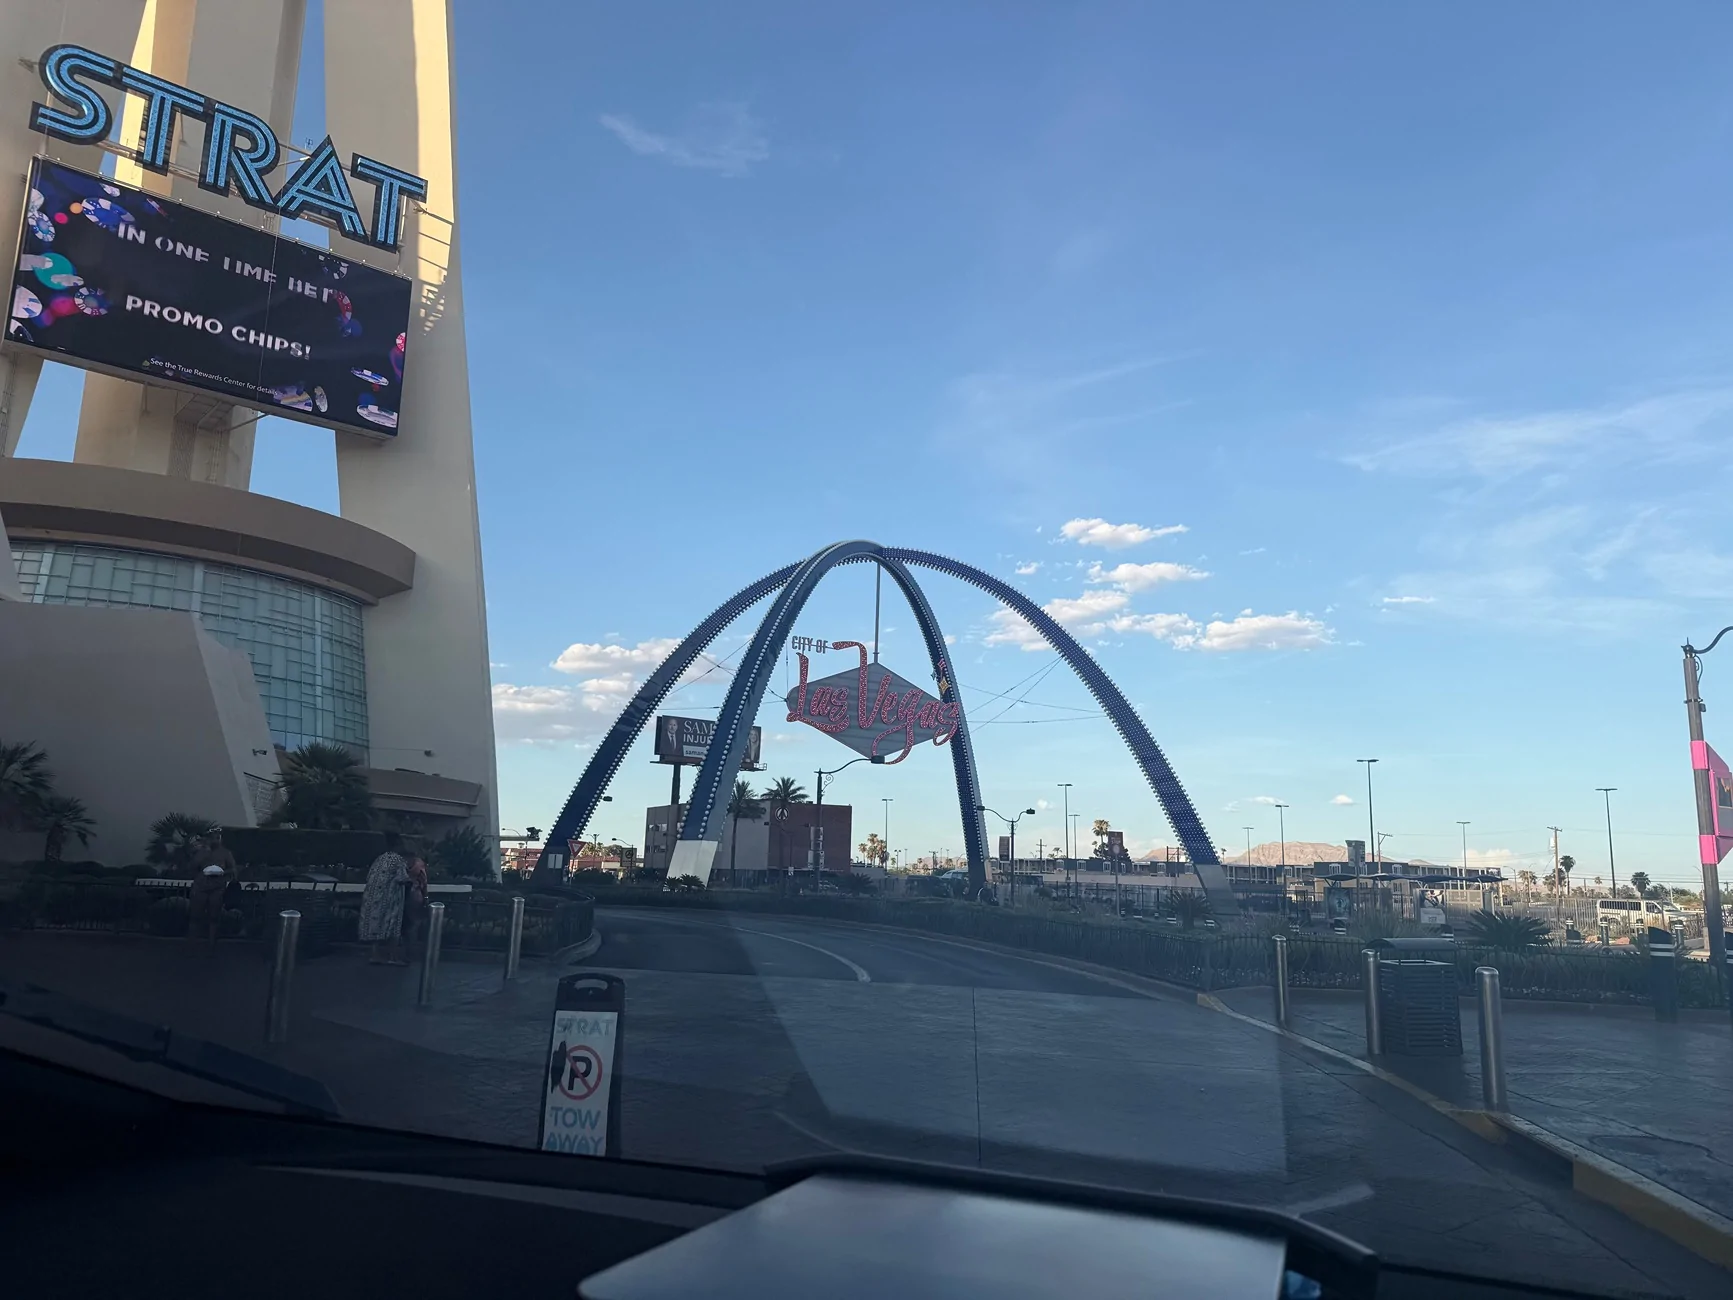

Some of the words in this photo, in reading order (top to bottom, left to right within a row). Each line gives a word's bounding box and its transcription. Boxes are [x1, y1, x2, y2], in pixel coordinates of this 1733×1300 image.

[29, 44, 428, 253] STRAT
[117, 222, 146, 245] IN
[125, 294, 223, 335] PROMO
[231, 325, 311, 360] CHIPS!
[150, 357, 164, 367] See
[164, 361, 177, 370] the
[178, 364, 193, 374] True
[193, 368, 223, 382] Rewards
[223, 376, 246, 387] Center
[246, 382, 256, 390] for
[791, 635, 813, 652] CITY
[815, 639, 829, 654] OF
[786, 651, 850, 733] Las
[832, 641, 960, 765] Vegas
[555, 1017, 615, 1036] STRAT
[550, 1106, 602, 1130] TOW
[545, 1131, 605, 1155] AWAY
